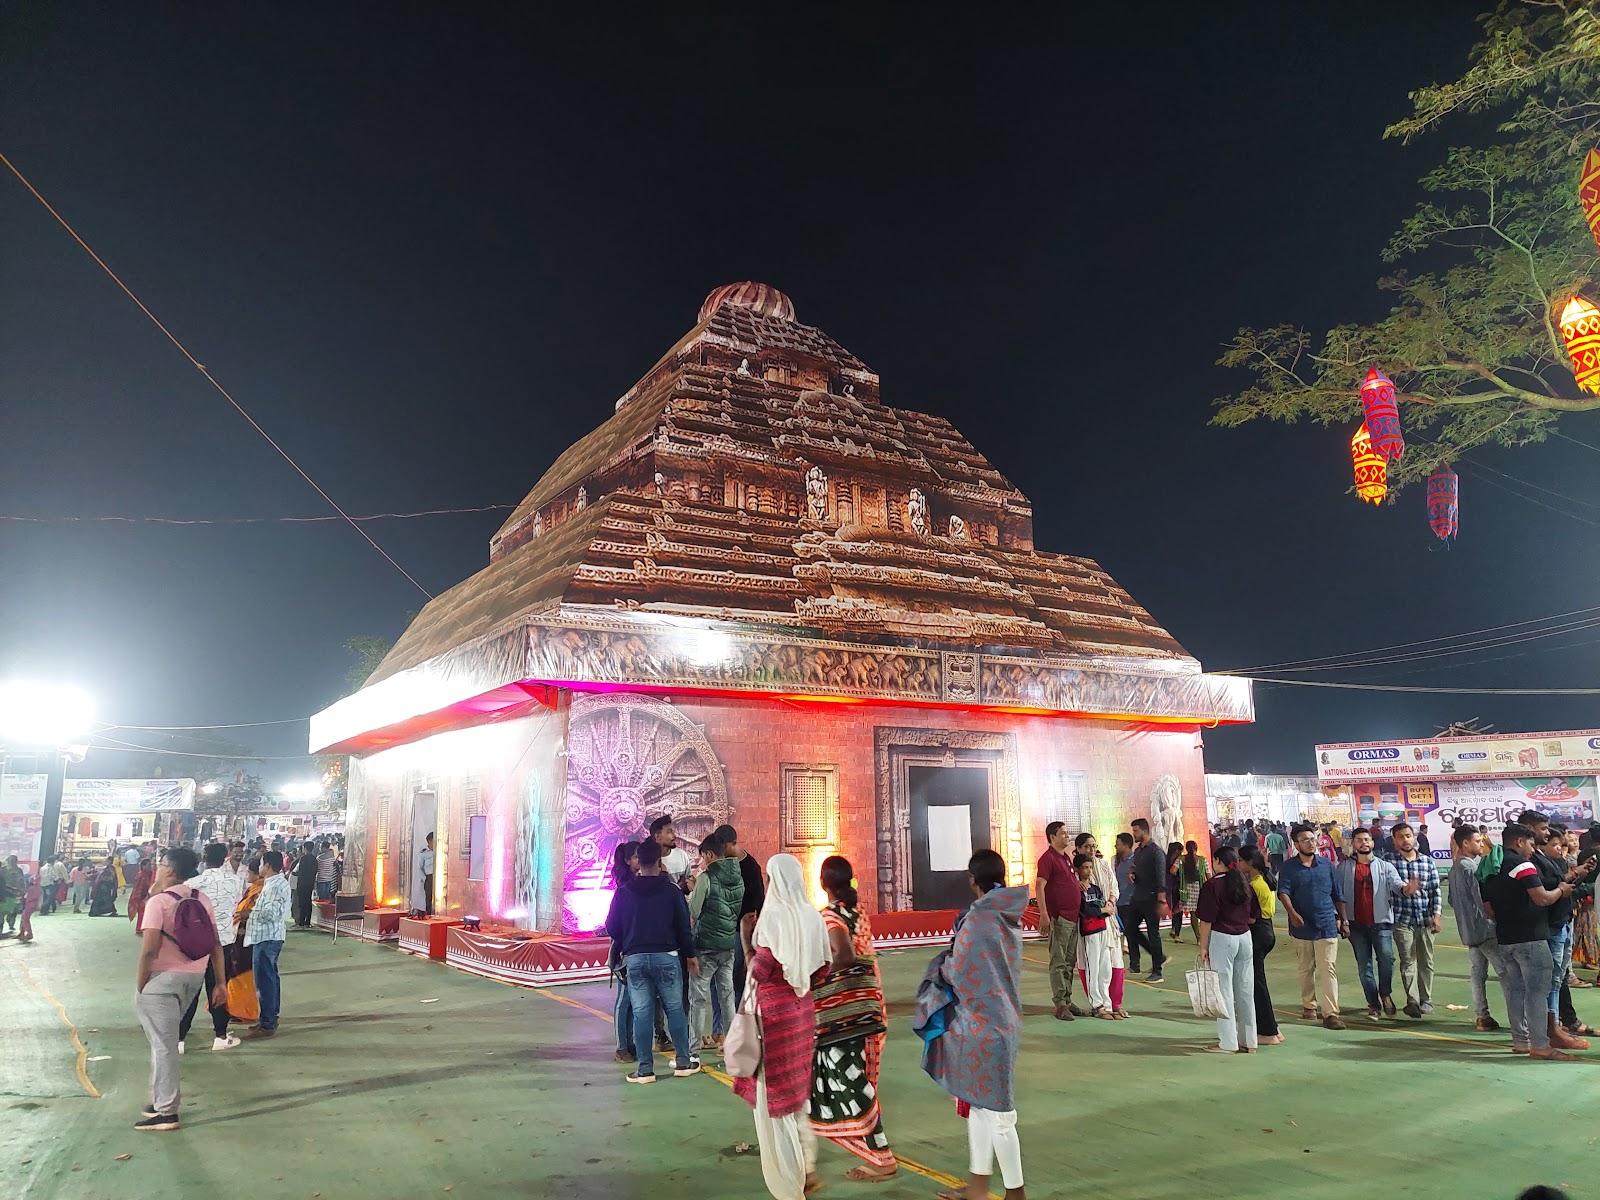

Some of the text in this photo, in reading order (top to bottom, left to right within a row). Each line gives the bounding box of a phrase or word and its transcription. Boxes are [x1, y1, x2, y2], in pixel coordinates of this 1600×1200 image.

[1353, 749, 1395, 759] ORMAS
[1324, 764, 1430, 776] NATIONAL LEVEL PALLISHREE MELA-2023
[1532, 784, 1569, 797] Bou
[1432, 850, 1452, 859] OR
